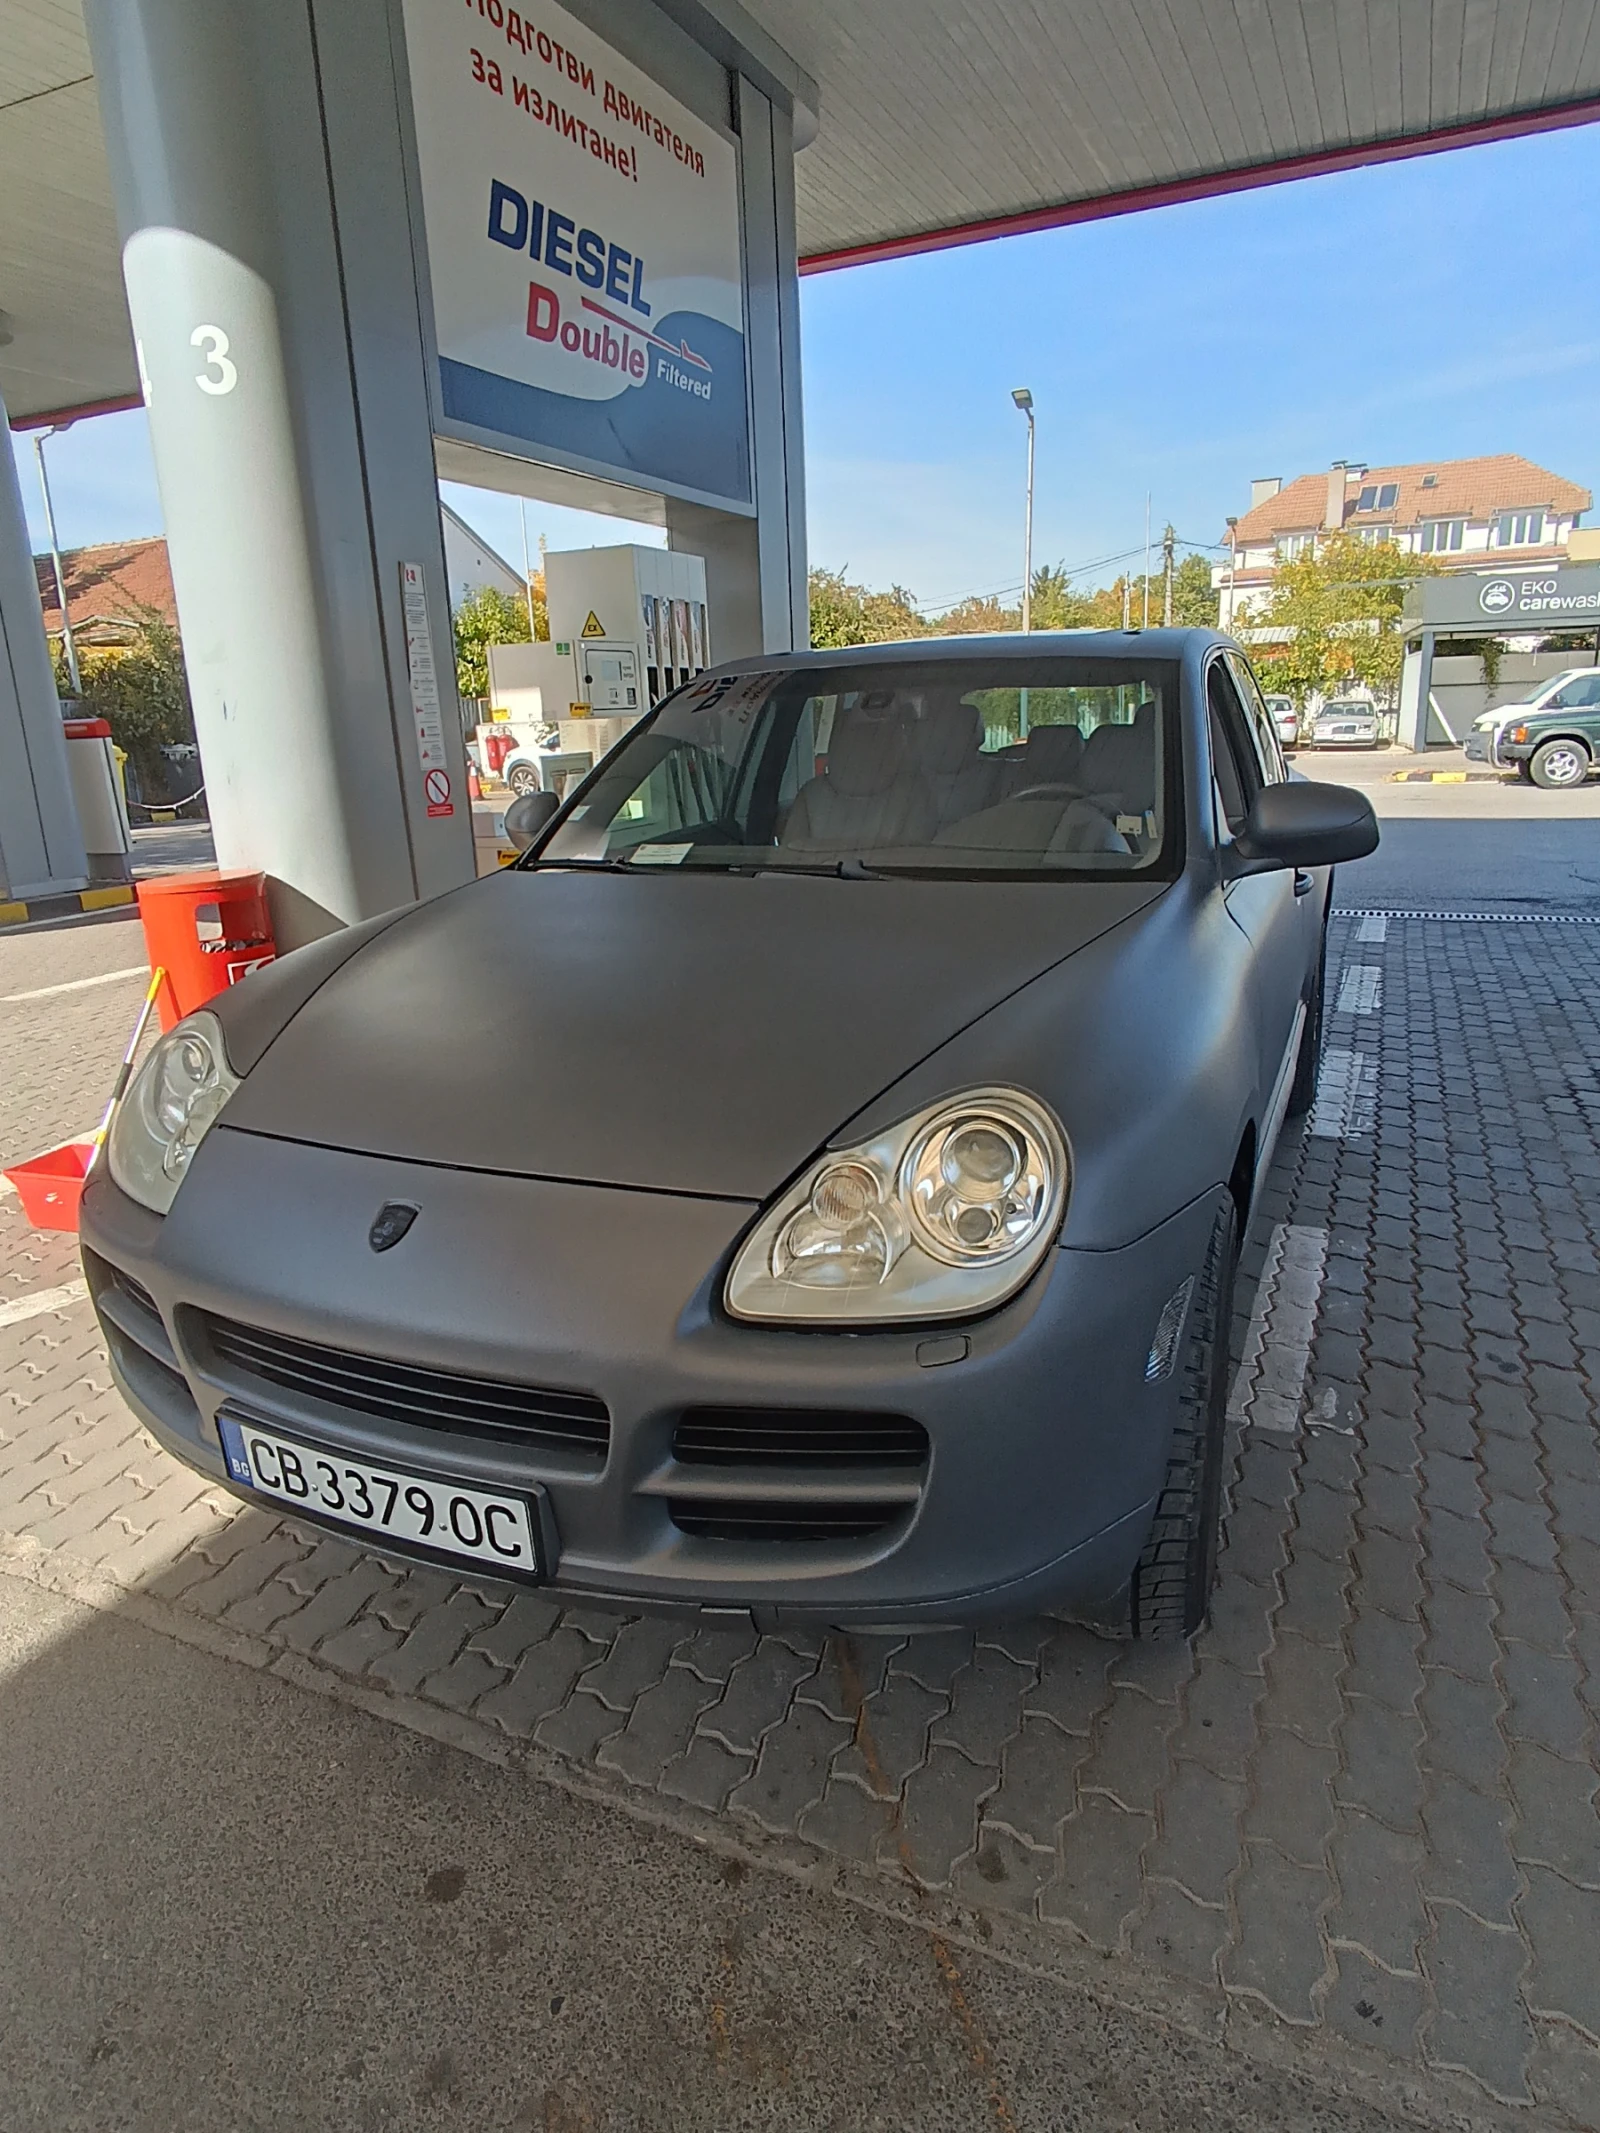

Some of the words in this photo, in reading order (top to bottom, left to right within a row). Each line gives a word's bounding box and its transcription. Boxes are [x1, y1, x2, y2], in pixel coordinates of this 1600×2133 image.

[470, 48, 503, 95] за
[513, 76, 638, 182] излитане!
[604, 81, 705, 177] двигателя
[487, 178, 651, 317] DIESEL
[190, 324, 237, 395] 3
[526, 281, 645, 379] Double
[656, 358, 712, 400] Filtered
[1521, 580, 1557, 594] EKO
[231, 1457, 250, 1477] BG
[250, 1438, 309, 1498] CB
[316, 1461, 435, 1536] 3379
